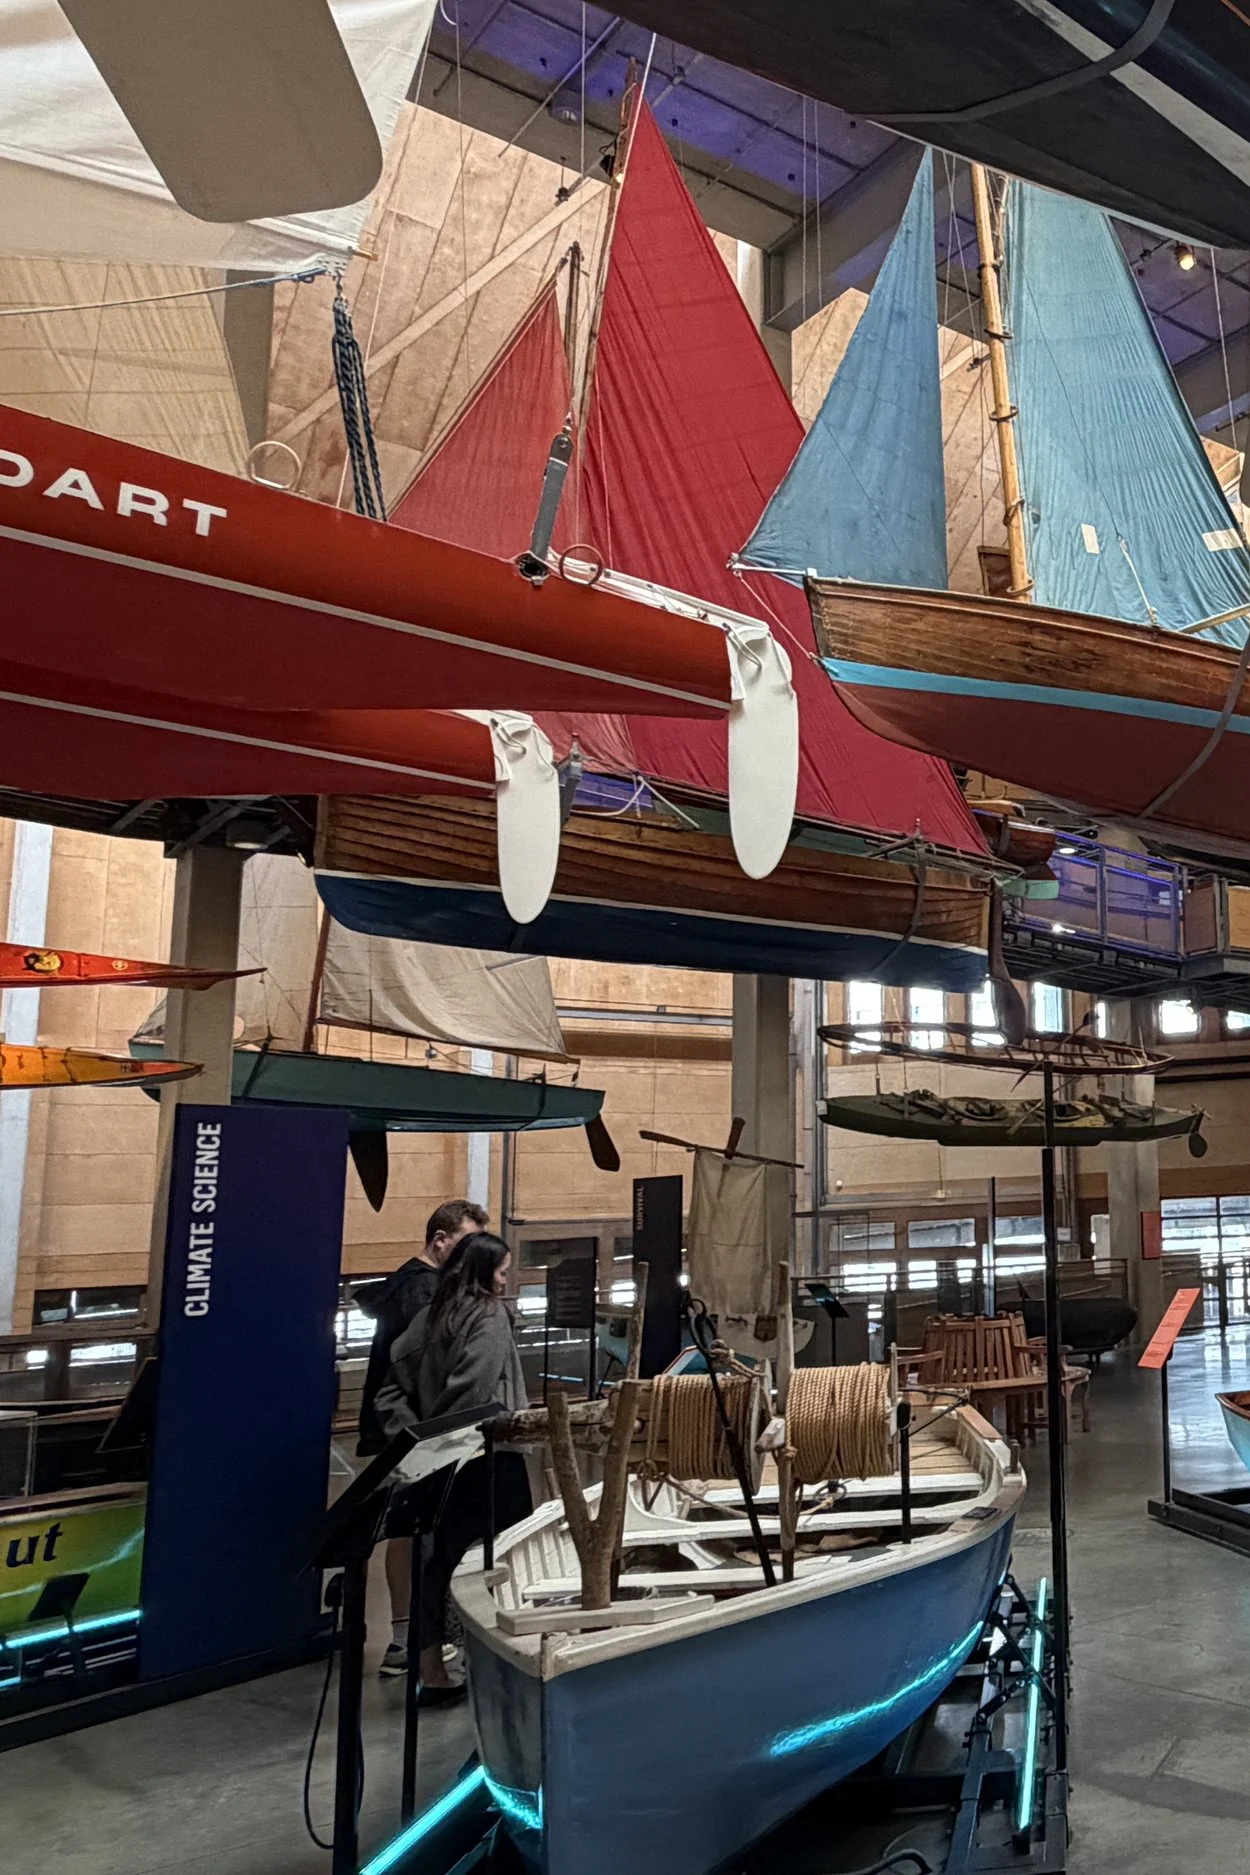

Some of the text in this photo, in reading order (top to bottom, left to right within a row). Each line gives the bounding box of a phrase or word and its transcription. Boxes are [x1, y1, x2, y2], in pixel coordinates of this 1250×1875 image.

[0, 449, 228, 537] DART
[184, 1122, 221, 1317] CLIMATE SCIENCE
[6, 1522, 64, 1569] ut
